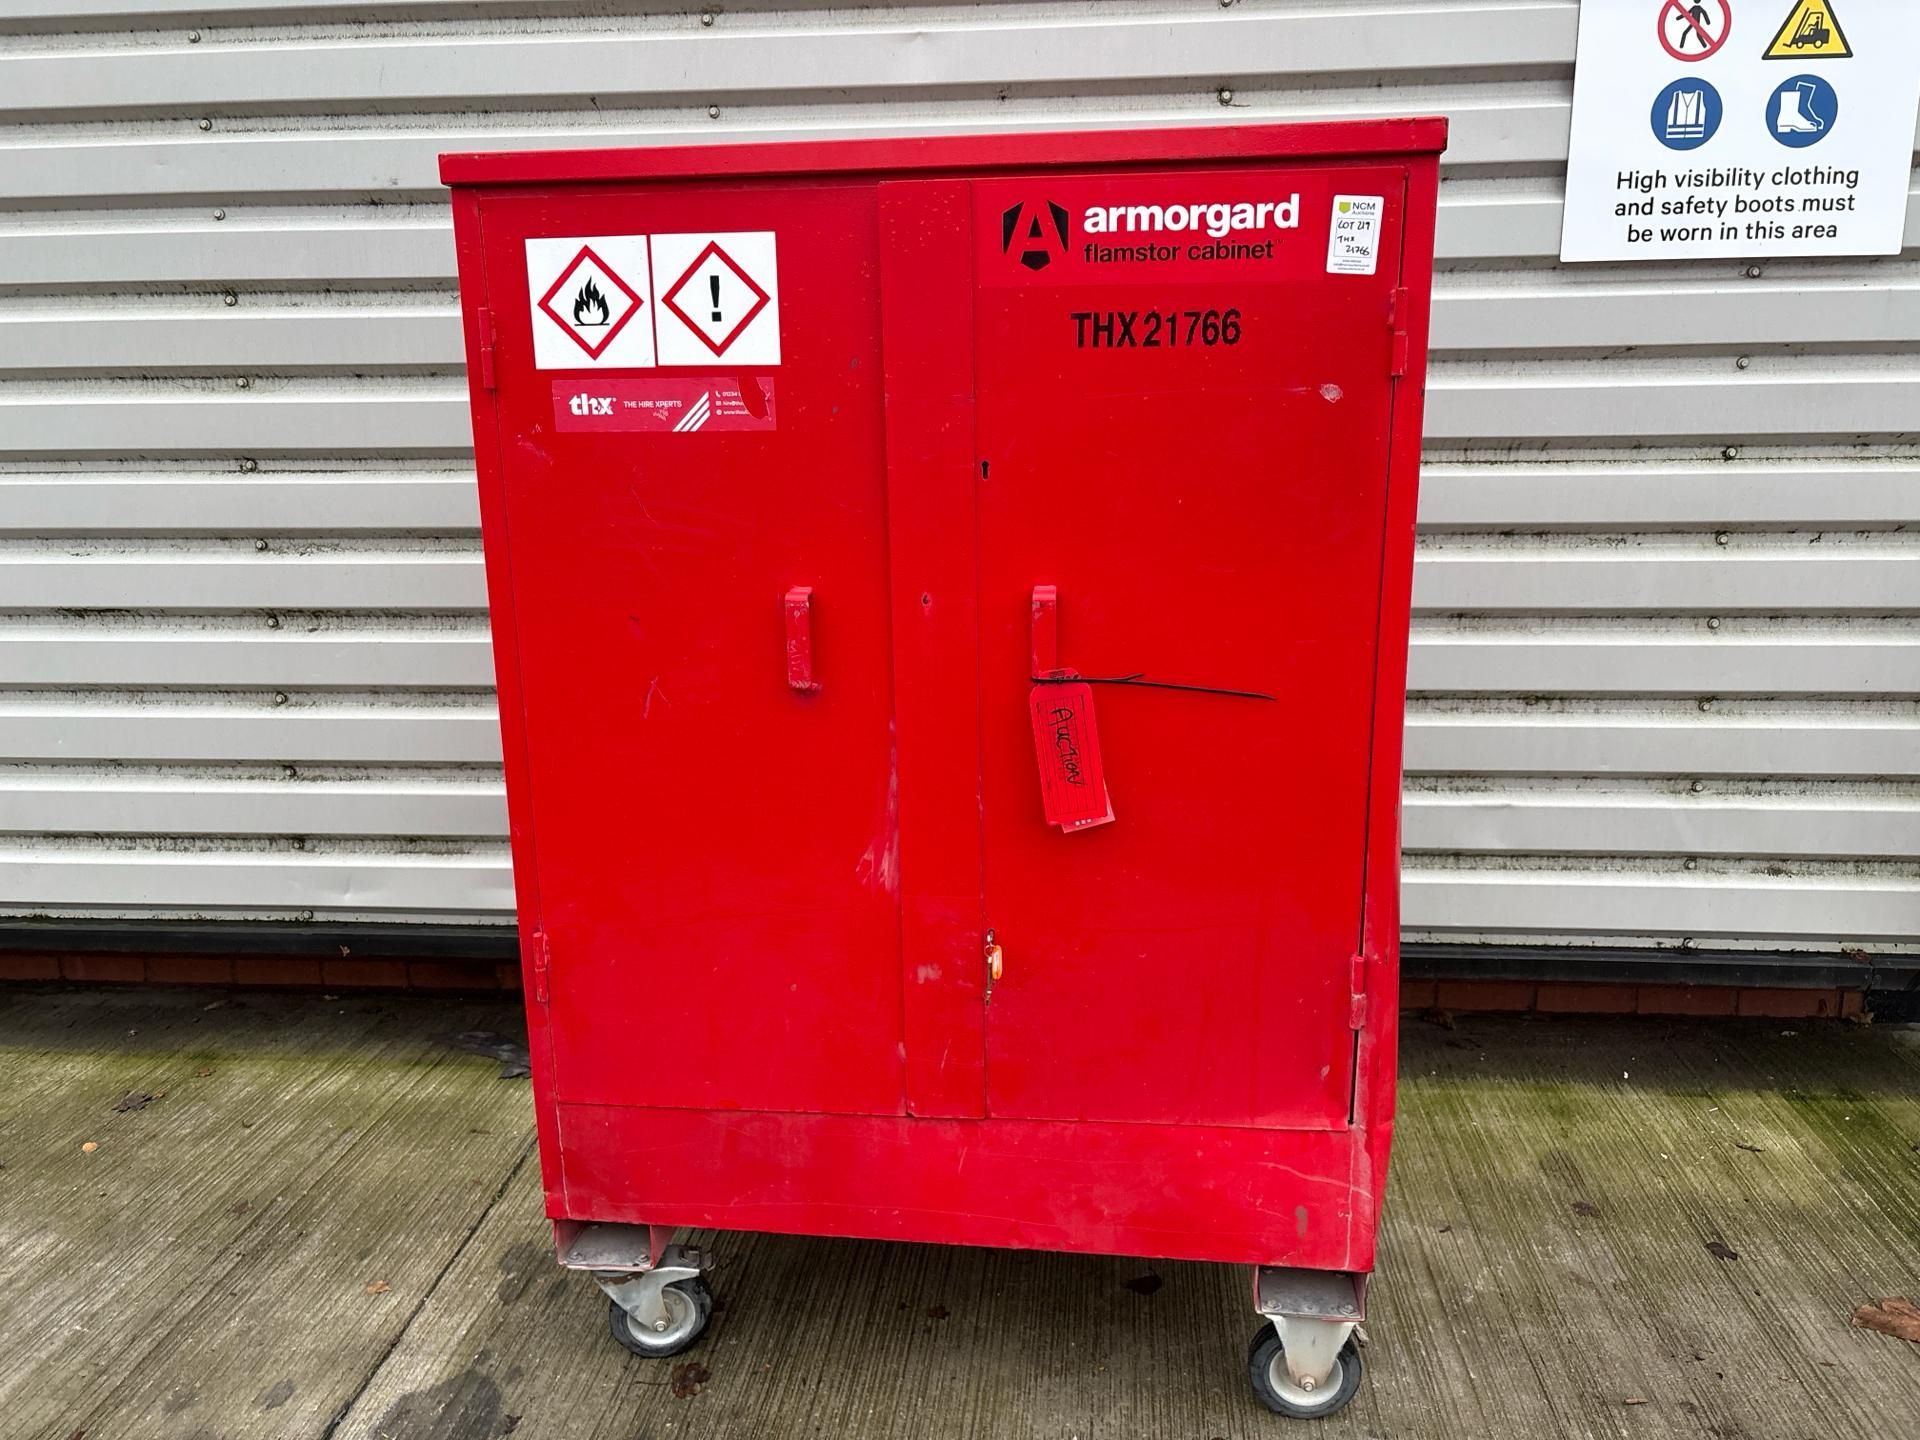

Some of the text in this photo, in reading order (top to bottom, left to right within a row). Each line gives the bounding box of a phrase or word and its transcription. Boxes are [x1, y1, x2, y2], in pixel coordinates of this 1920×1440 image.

[1617, 165, 1860, 193] High visibility clothing
[1083, 193, 1300, 237] armorgard
[1352, 201, 1376, 211] NCM
[1614, 193, 1856, 218] and safety boots must
[1338, 220, 1355, 230] LOT
[1627, 220, 1838, 243] be worn in this area
[1083, 239, 1274, 263] flamstor cabinet
[1345, 245, 1370, 256] 21766
[623, 400, 683, 409] THE HIRE XPERTS
